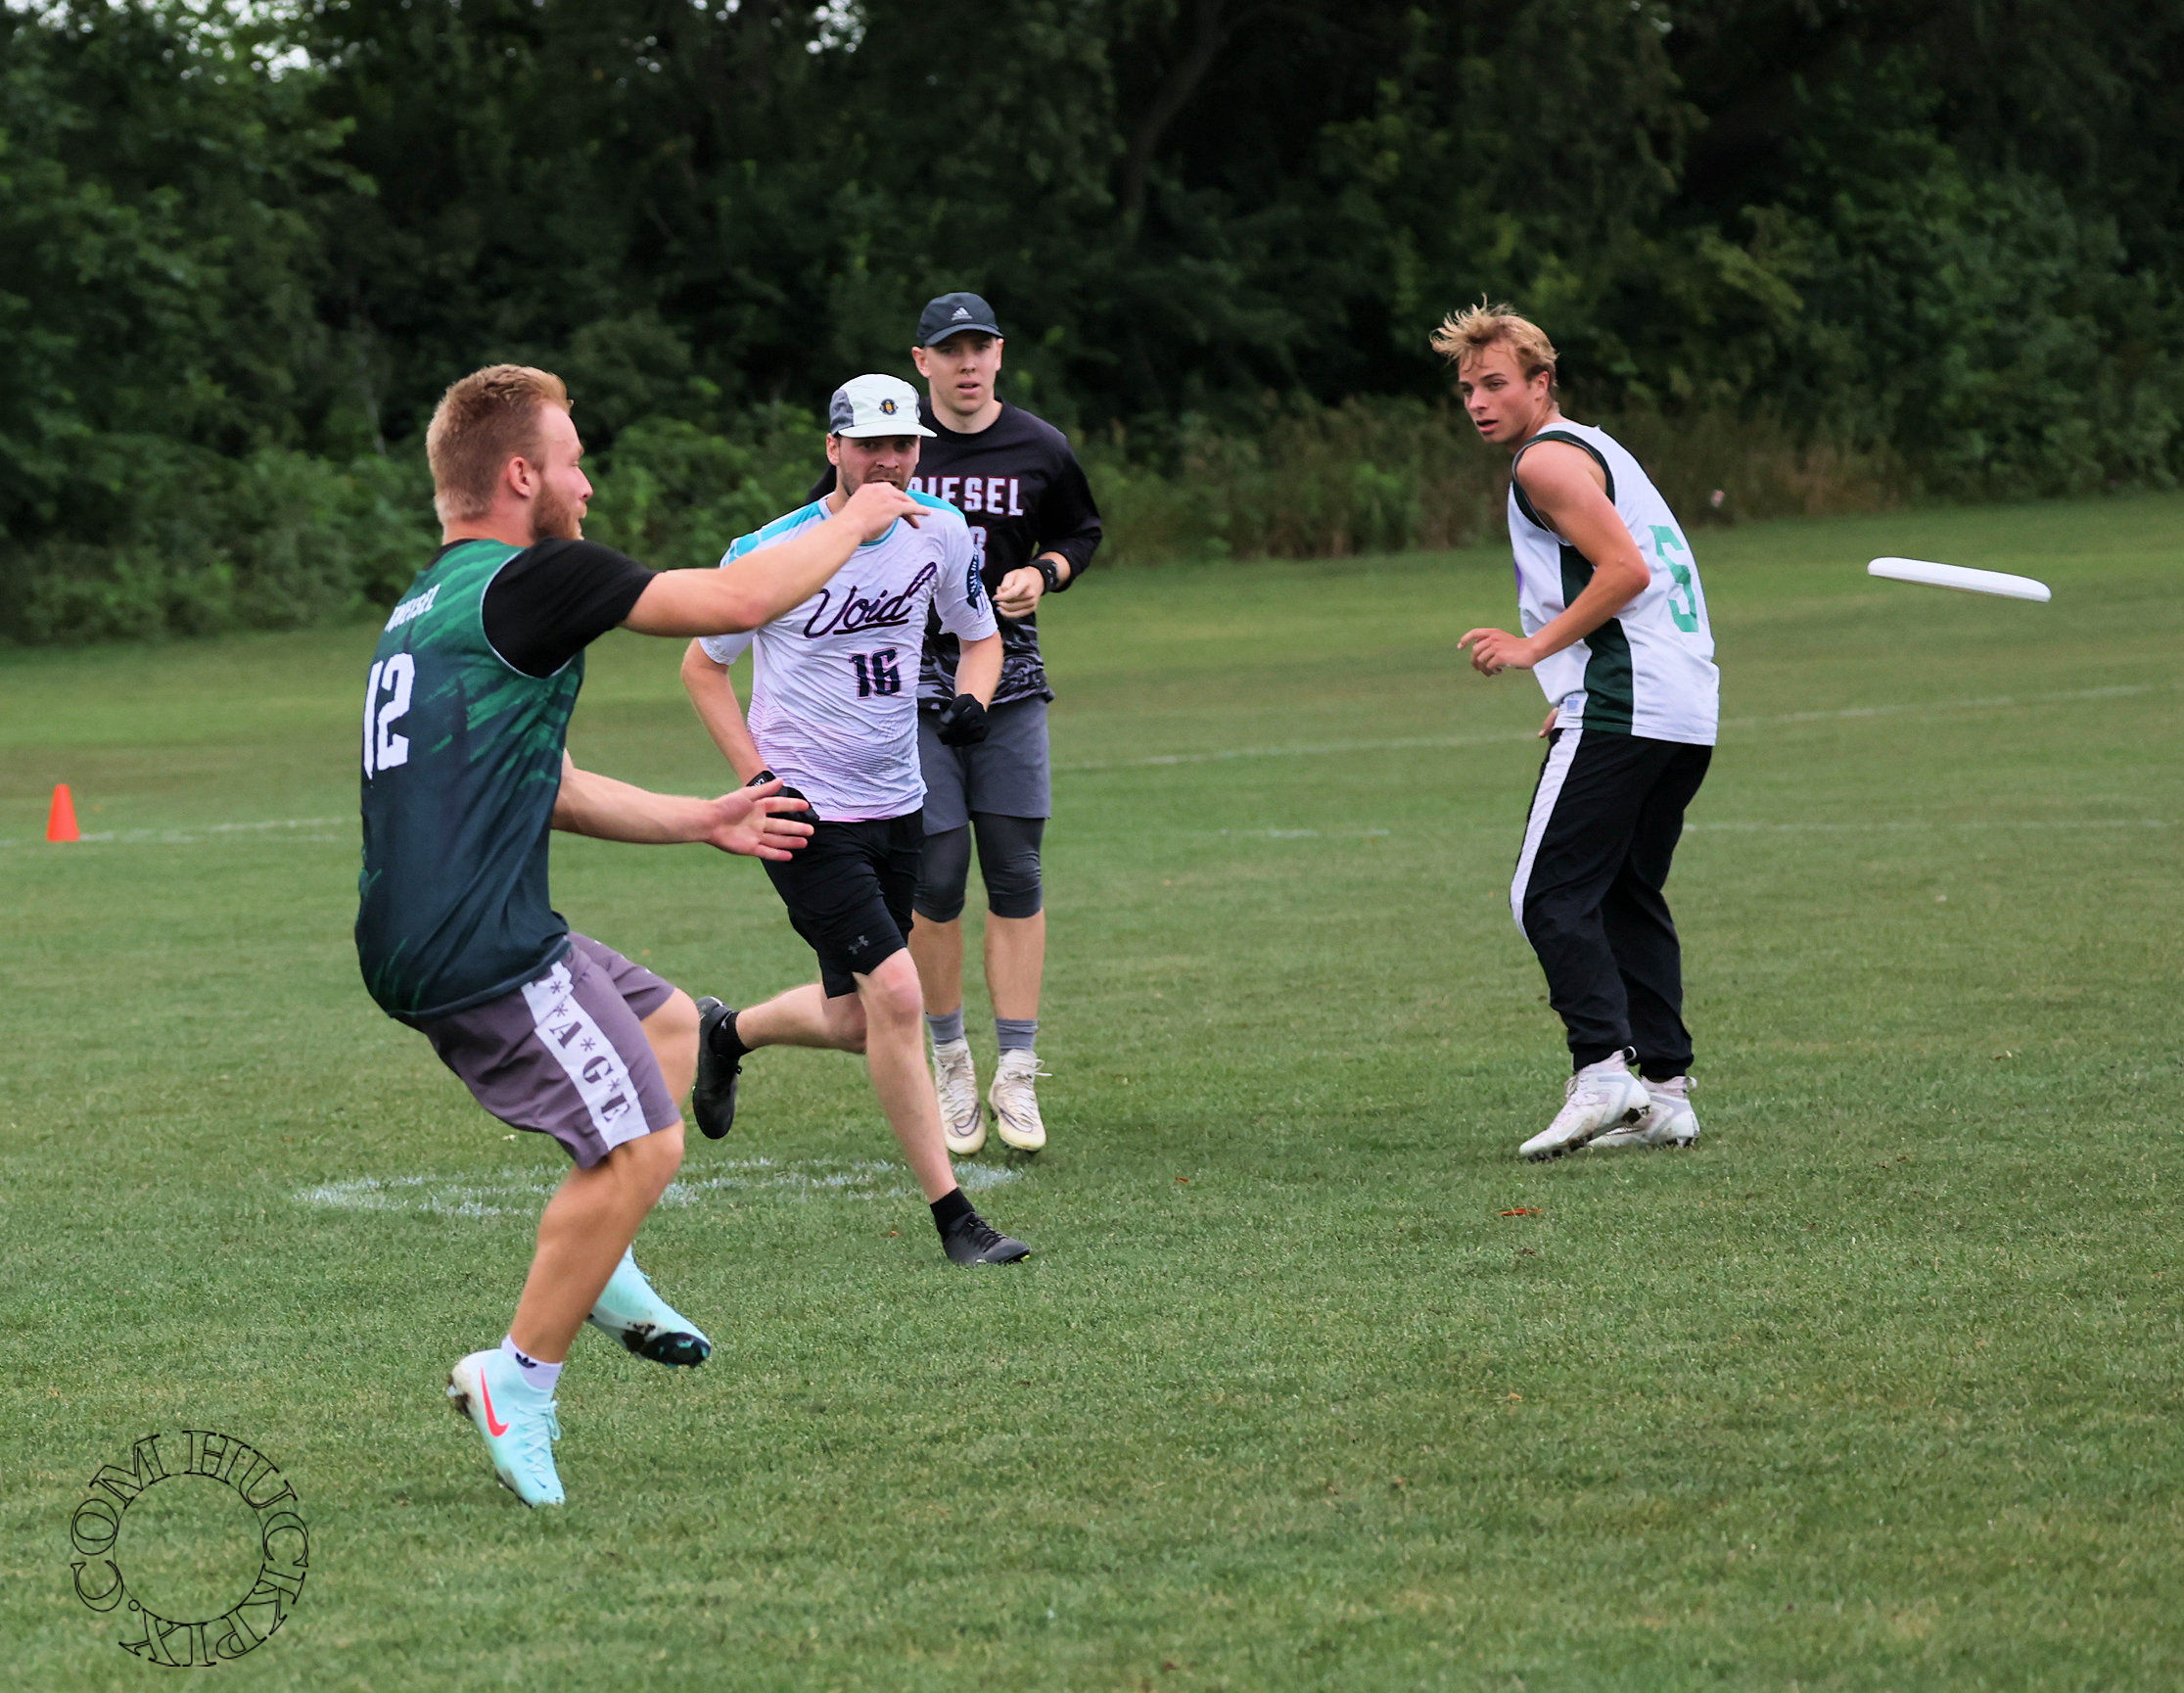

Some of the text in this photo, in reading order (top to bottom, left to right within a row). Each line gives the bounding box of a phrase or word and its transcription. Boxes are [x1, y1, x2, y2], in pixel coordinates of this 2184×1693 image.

[803, 560, 938, 639] Void
[848, 646, 903, 701] 16
[362, 651, 416, 780] 12
